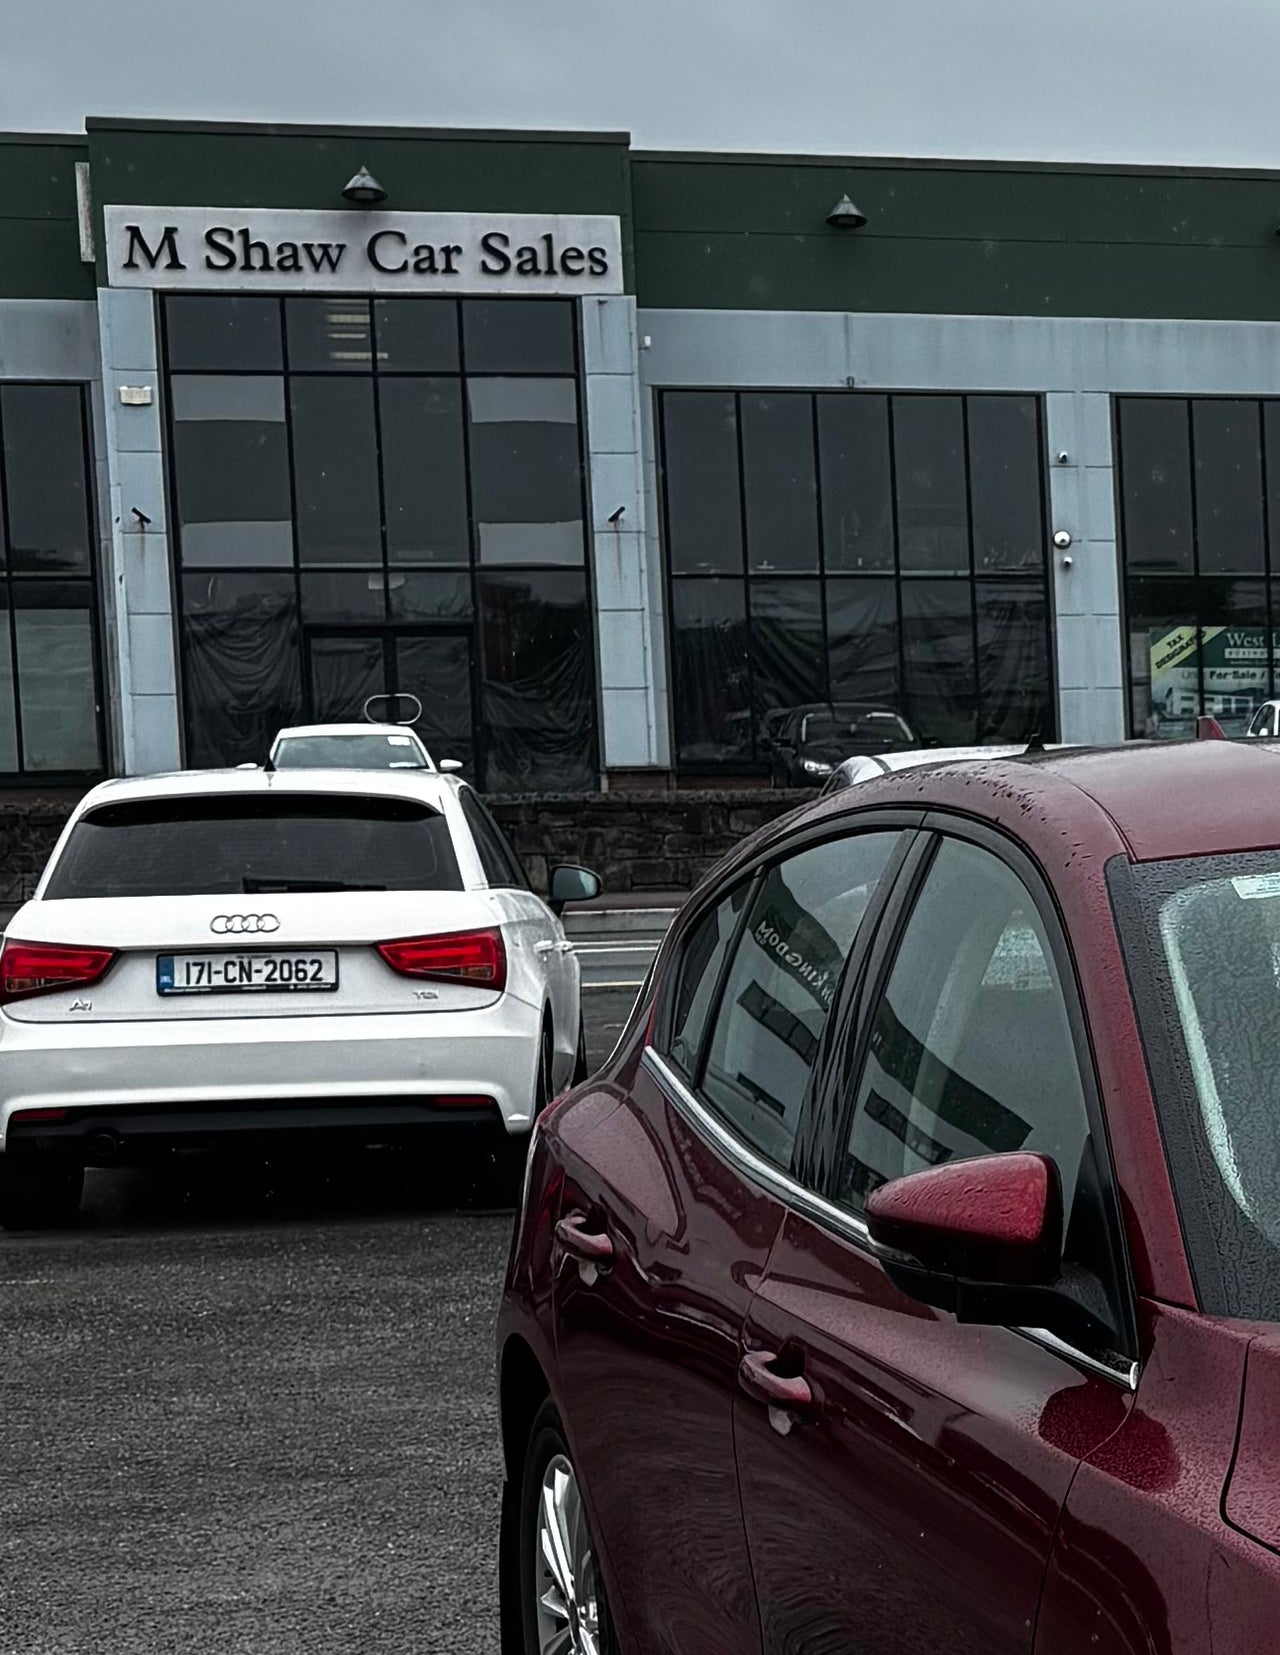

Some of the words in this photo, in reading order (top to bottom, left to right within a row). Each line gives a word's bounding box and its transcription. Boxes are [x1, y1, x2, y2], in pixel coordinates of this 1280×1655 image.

[123, 224, 187, 272] M
[204, 226, 346, 274] Shaw
[367, 230, 463, 276] Car
[480, 232, 609, 277] Sales
[1227, 632, 1265, 647] West
[185, 959, 323, 985] 171-CN-2062
